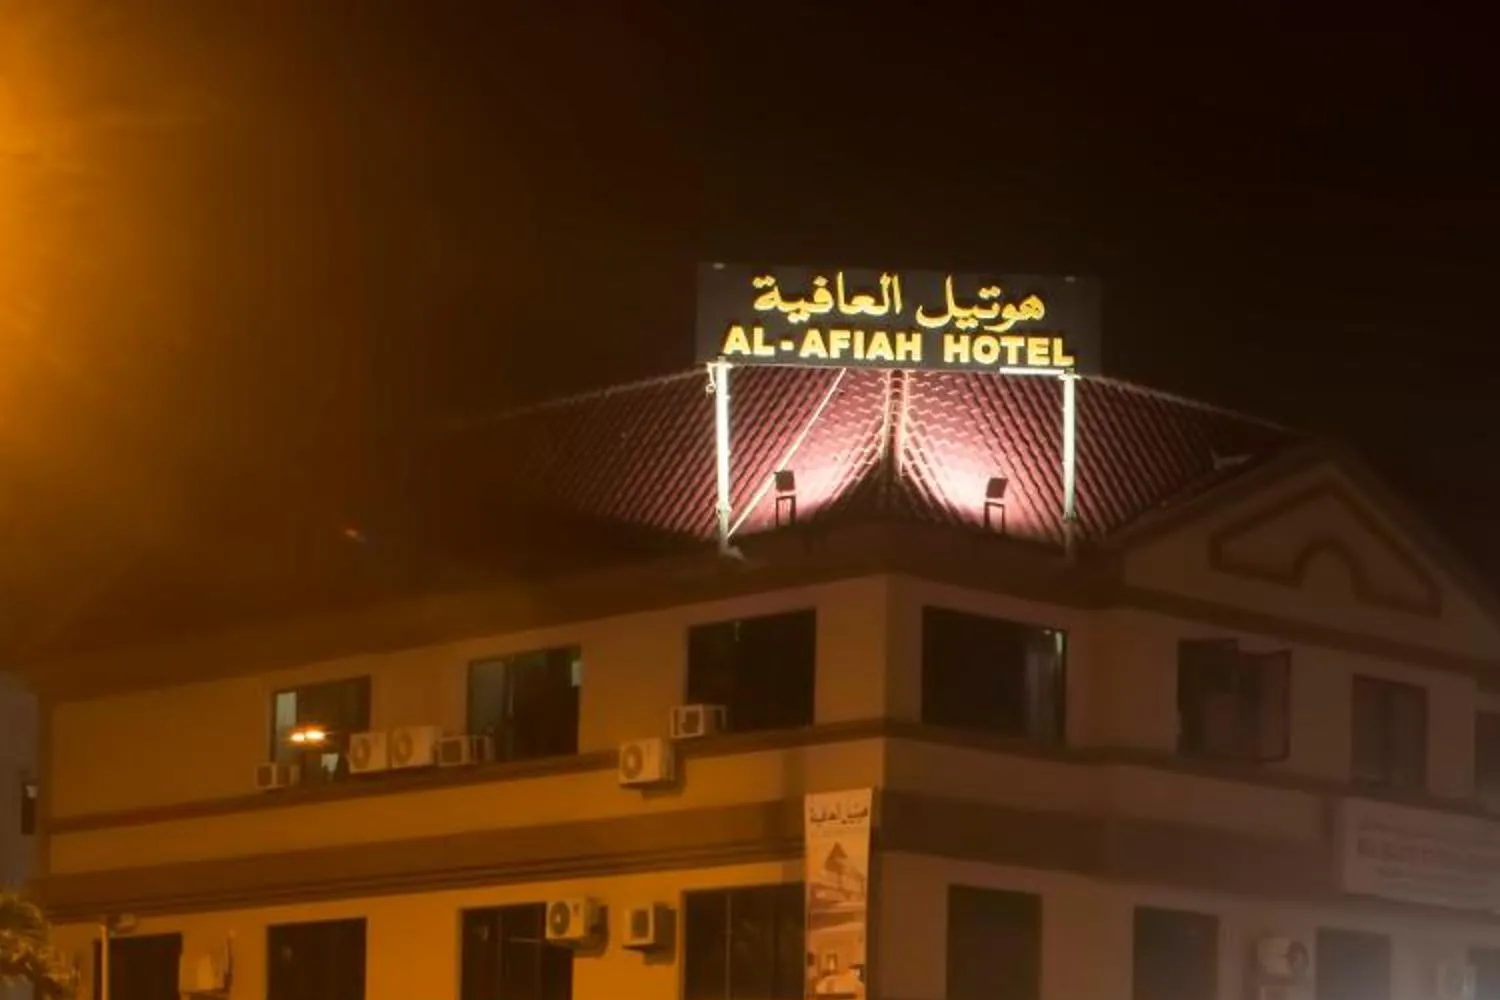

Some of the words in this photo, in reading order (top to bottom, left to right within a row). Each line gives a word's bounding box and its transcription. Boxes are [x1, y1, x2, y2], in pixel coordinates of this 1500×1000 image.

[751, 271, 902, 324] العافية
[915, 274, 1046, 331] هوتيل
[724, 325, 922, 361] AL-AFIAH
[943, 334, 1074, 367] HOTEL
